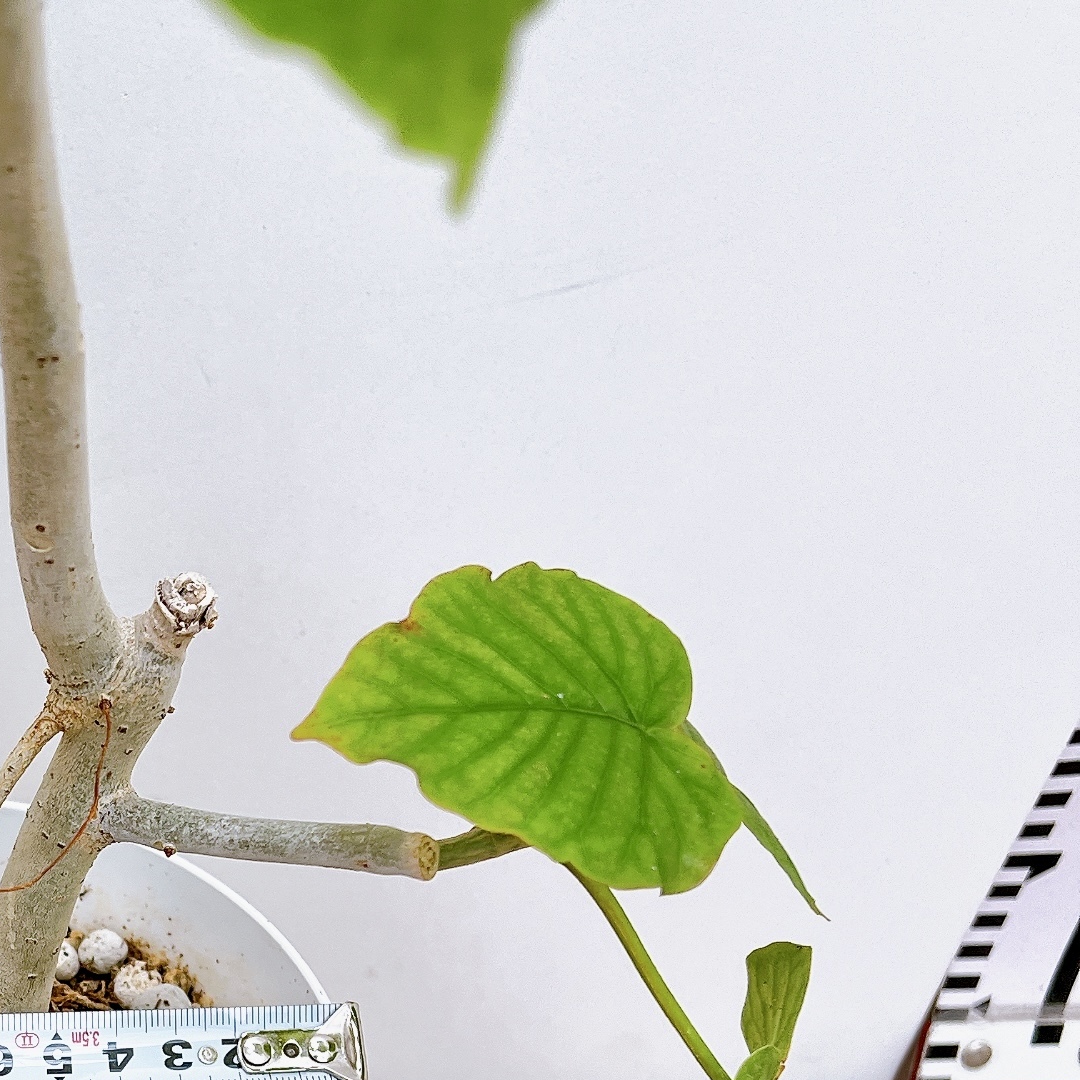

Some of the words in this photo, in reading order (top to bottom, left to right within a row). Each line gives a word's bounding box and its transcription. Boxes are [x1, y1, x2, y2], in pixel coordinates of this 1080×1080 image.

[71, 1031, 100, 1047] 3.5m
[162, 1039, 193, 1070] 3
[43, 1043, 72, 1075] 5
[102, 1041, 134, 1073] 4
